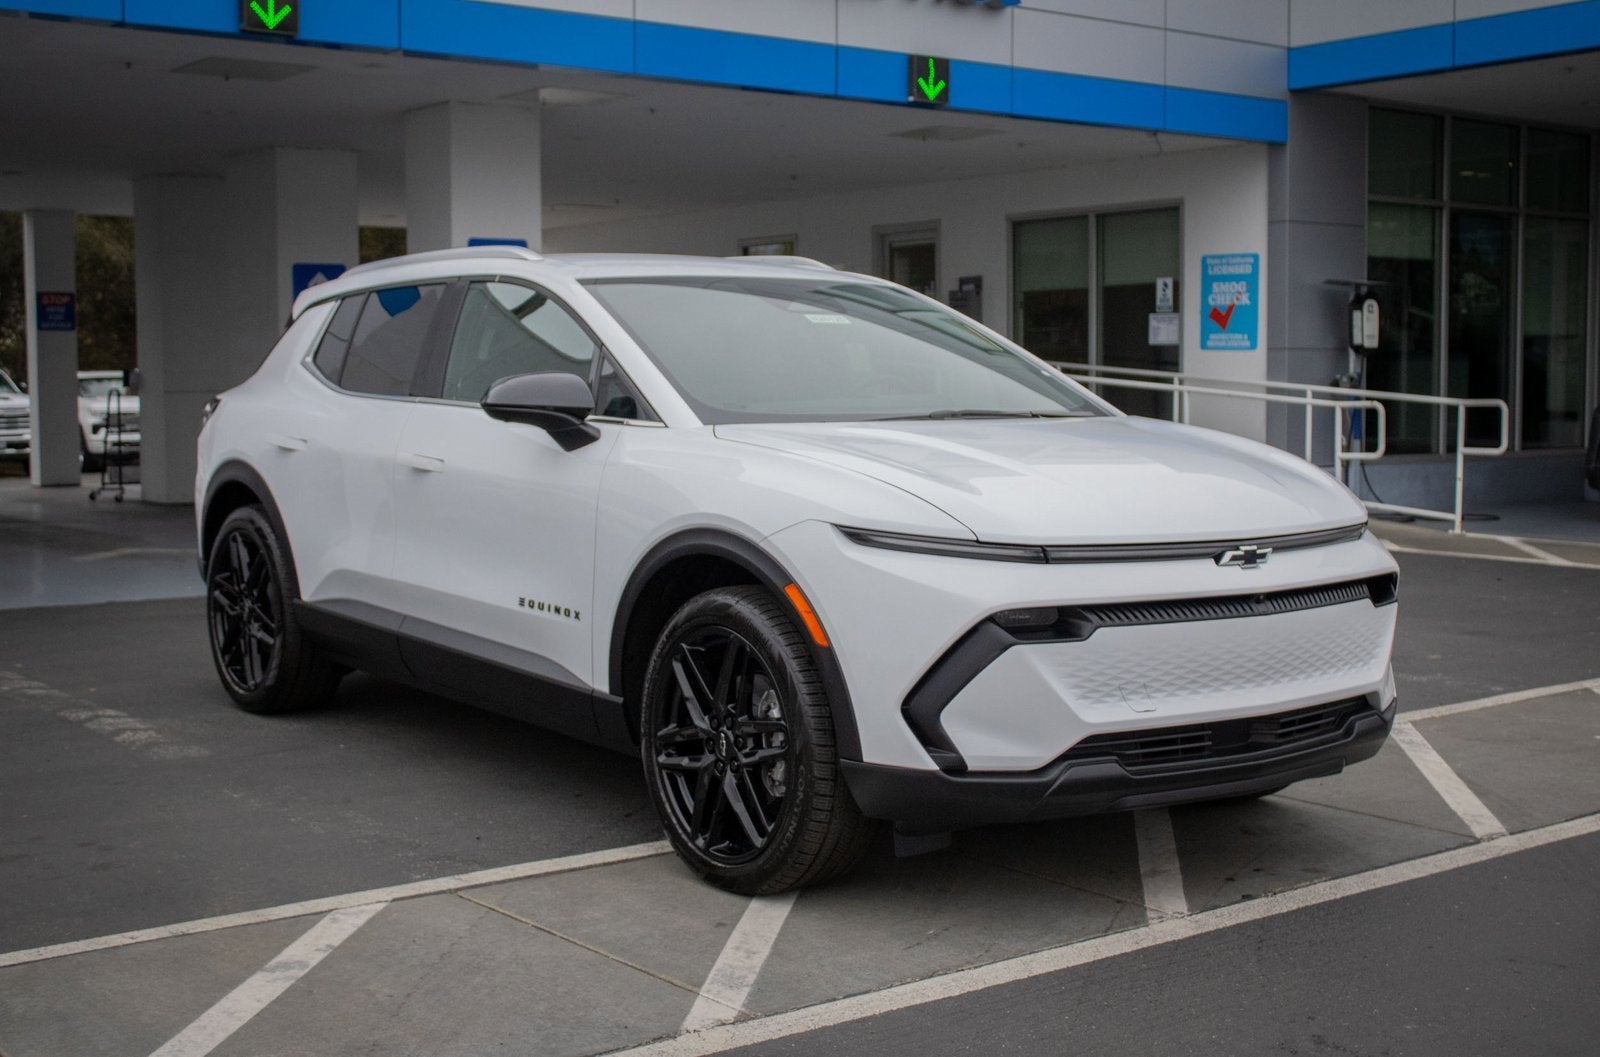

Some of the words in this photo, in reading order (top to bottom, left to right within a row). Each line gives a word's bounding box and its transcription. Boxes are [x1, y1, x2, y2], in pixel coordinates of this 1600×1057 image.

[1208, 264, 1253, 275] LICENSED
[1212, 281, 1247, 293] SMOG
[41, 295, 71, 304] STOP
[1208, 292, 1251, 306] CHECK
[518, 597, 581, 621] EQUINOX
